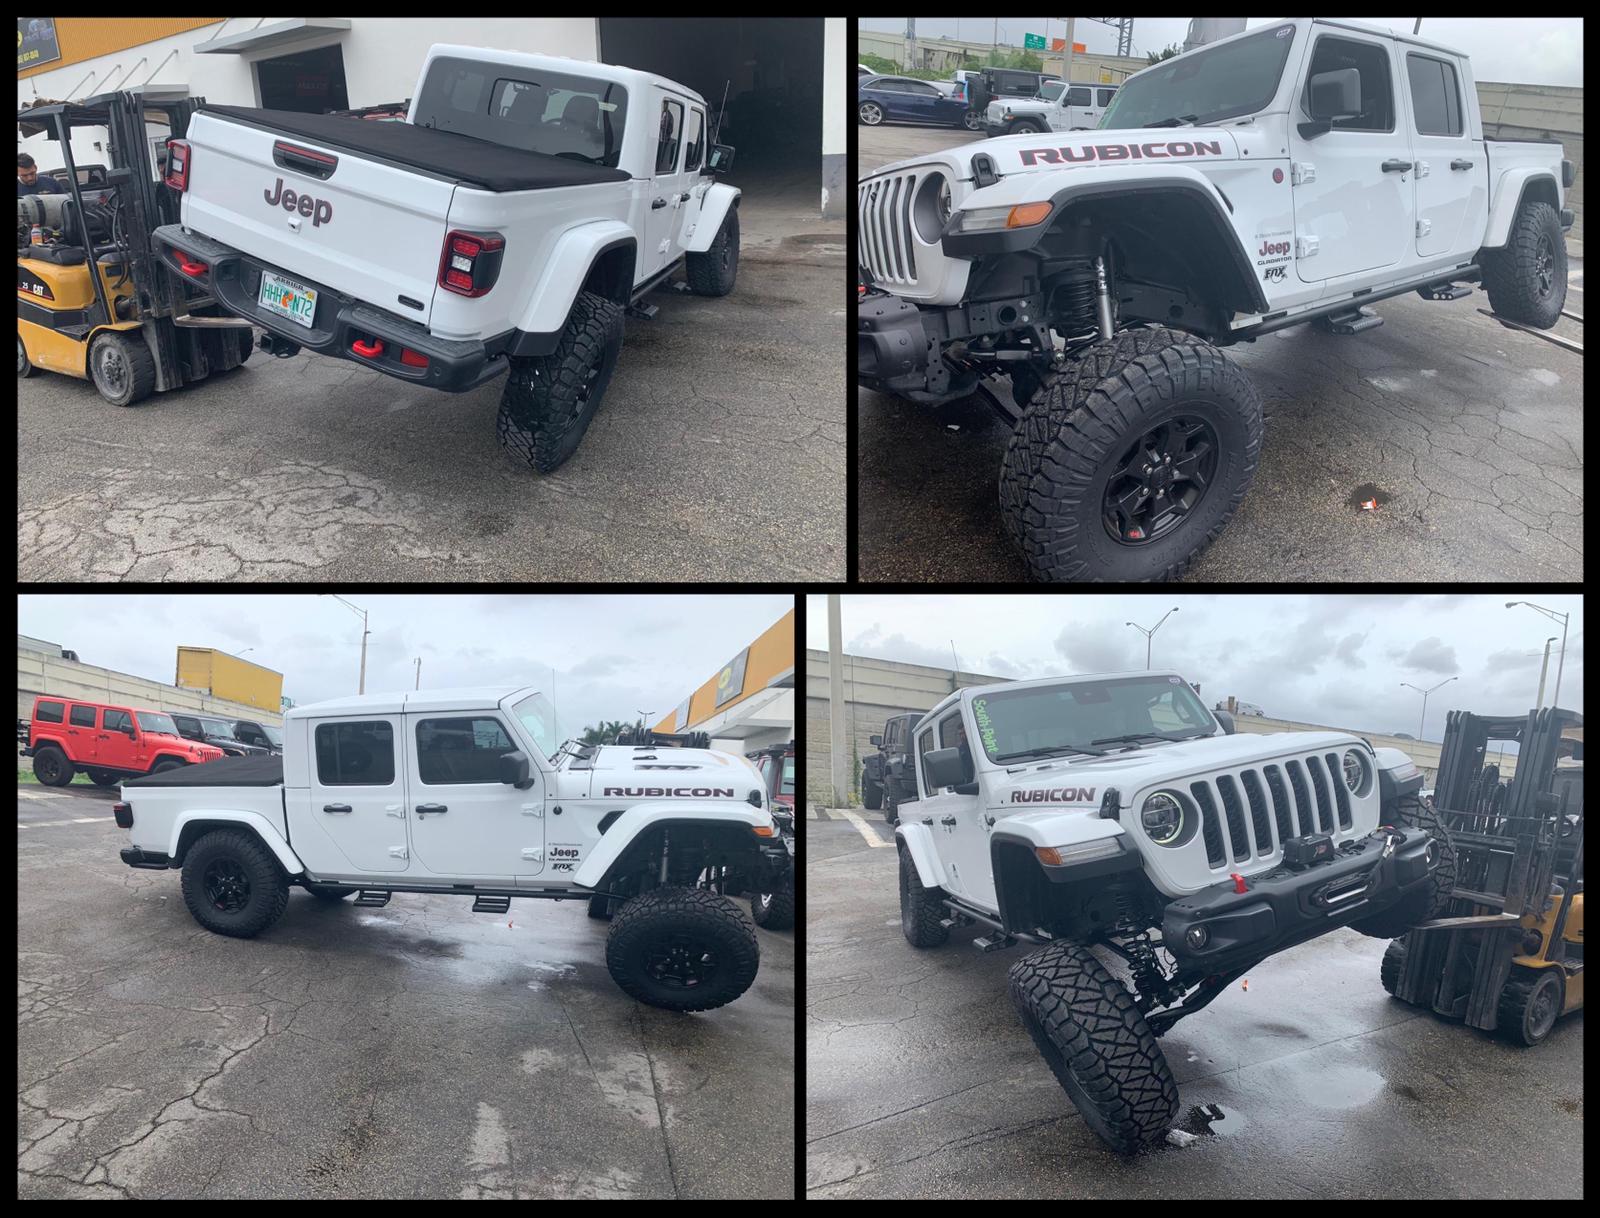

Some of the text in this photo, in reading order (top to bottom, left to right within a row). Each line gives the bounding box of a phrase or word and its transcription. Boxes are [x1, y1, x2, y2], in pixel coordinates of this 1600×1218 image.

[1019, 141, 1222, 166] RUBICON
[264, 177, 332, 228] Jeep
[1258, 240, 1291, 257] Jeep
[32, 283, 44, 296] CAT
[603, 787, 735, 798] RUBICON
[1011, 787, 1097, 803] RUBICON
[550, 847, 579, 858] Jeep
